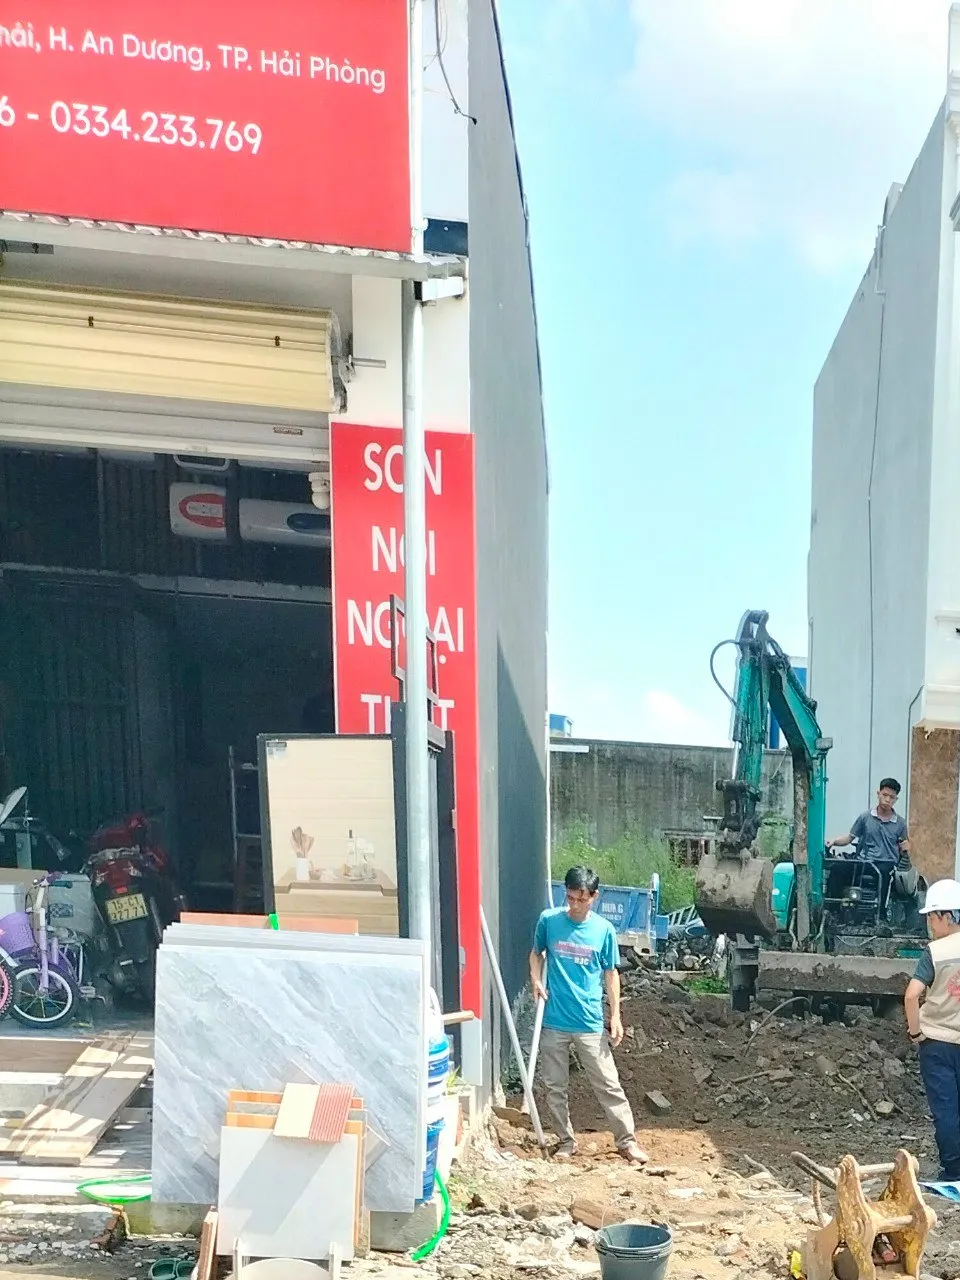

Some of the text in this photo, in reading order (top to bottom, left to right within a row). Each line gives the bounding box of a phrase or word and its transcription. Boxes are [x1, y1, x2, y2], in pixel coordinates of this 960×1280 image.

[49, 26, 74, 51] H.
[81, 29, 114, 55] An
[122, 33, 211, 72] Dương,
[217, 44, 252, 71] TP.
[260, 49, 301, 77] Hải
[310, 56, 386, 94] Phòng
[50, 100, 262, 154] 0334.233.769
[371, 525, 436, 576] NI
[347, 599, 464, 665] NGẠI
